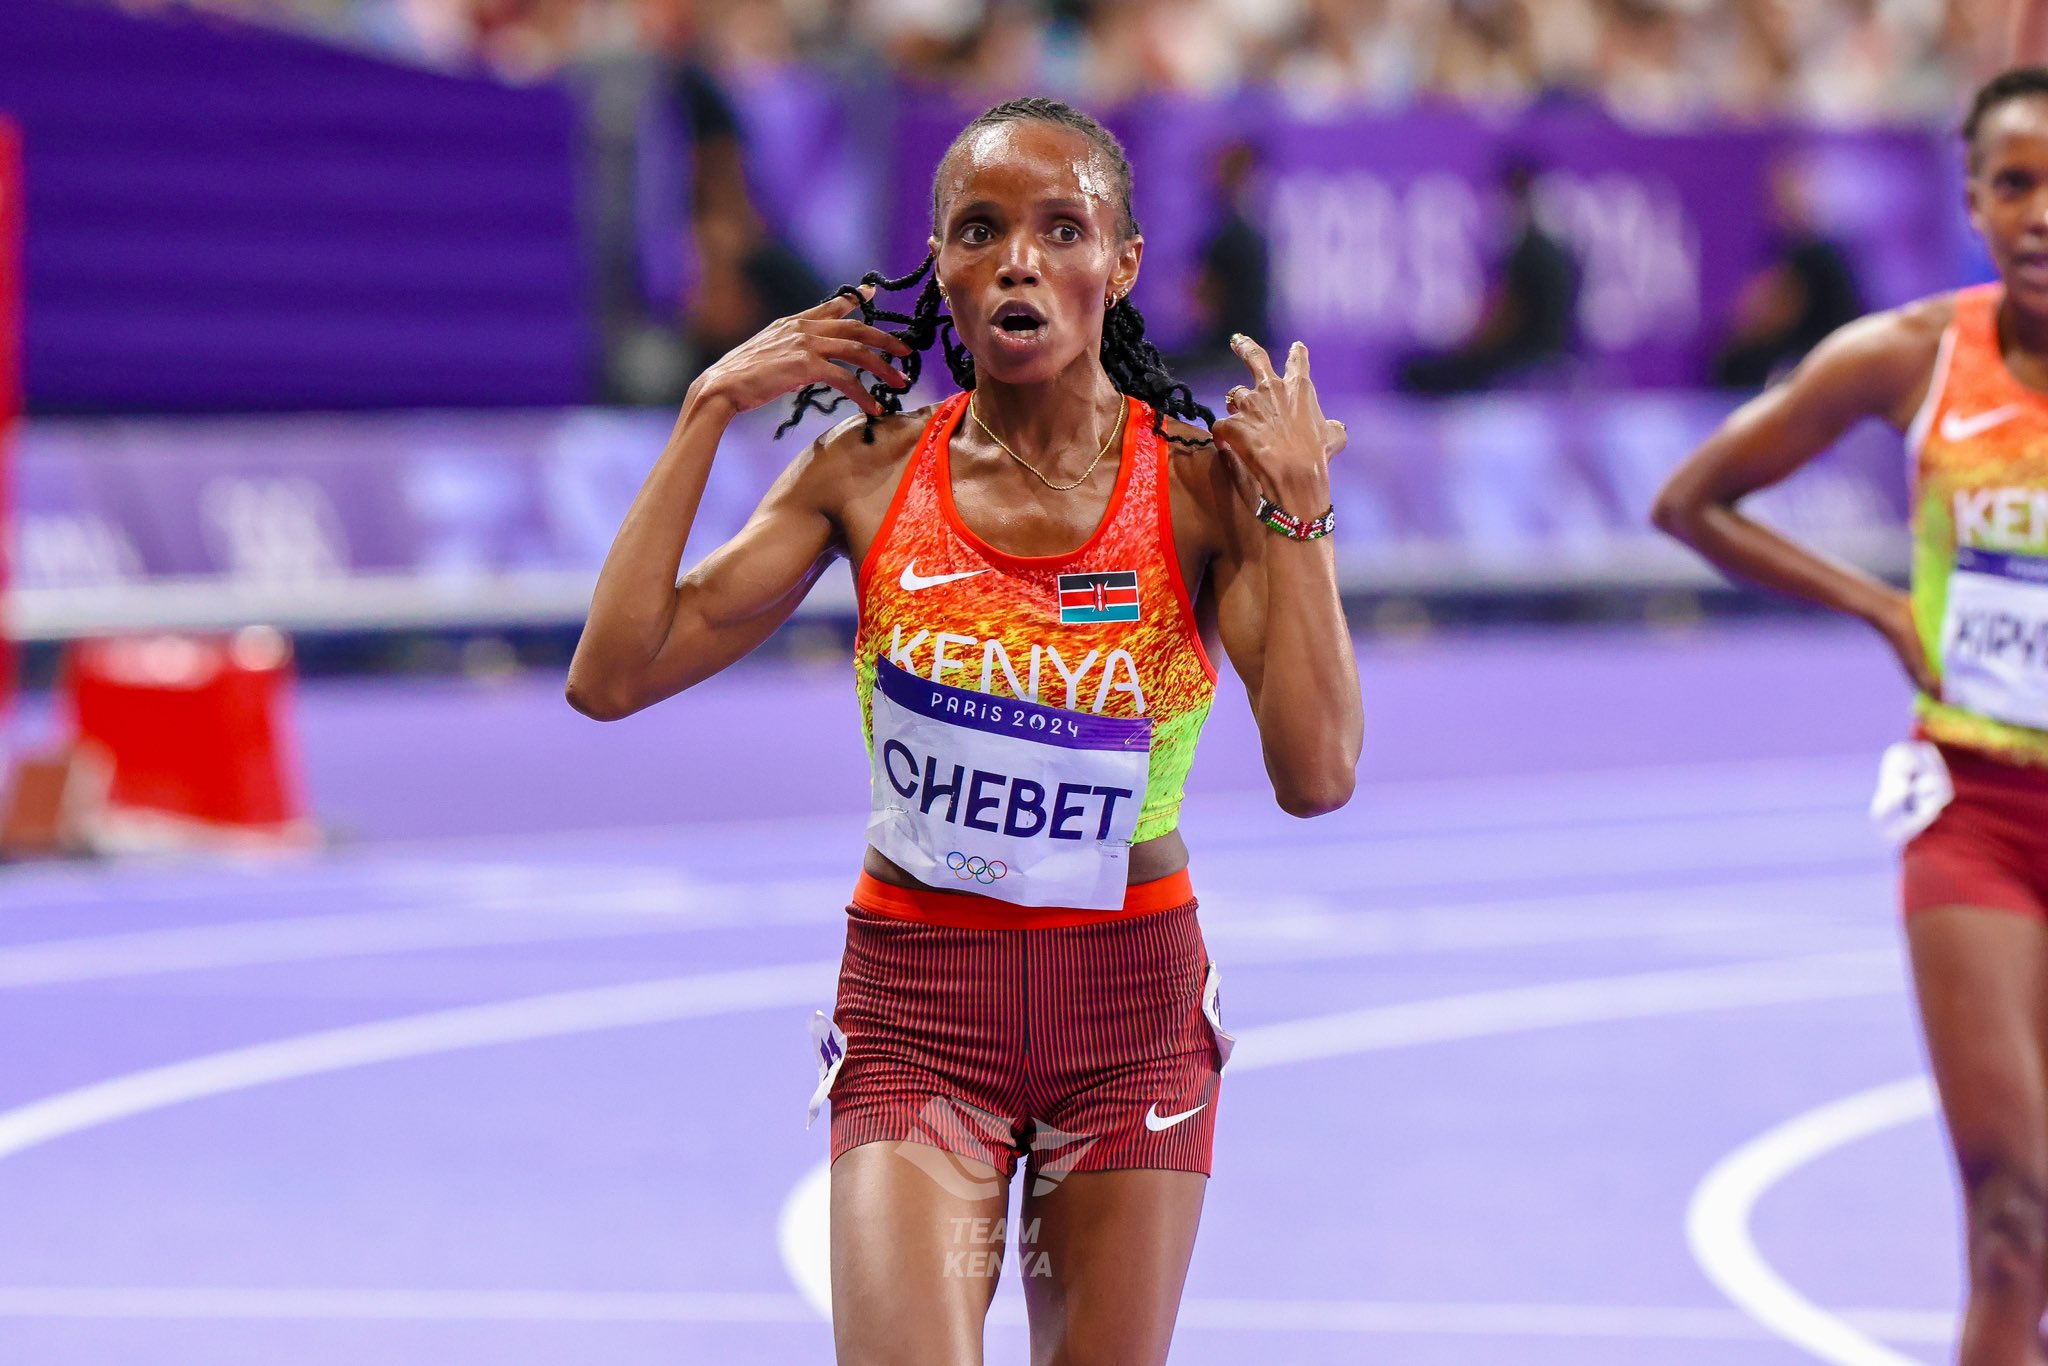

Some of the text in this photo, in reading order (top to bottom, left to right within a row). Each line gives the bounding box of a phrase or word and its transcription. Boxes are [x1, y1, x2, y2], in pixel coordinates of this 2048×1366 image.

[889, 623, 1146, 714] KENYA
[930, 692, 1079, 738] PARIS 2024
[883, 738, 1133, 841] CHEBET
